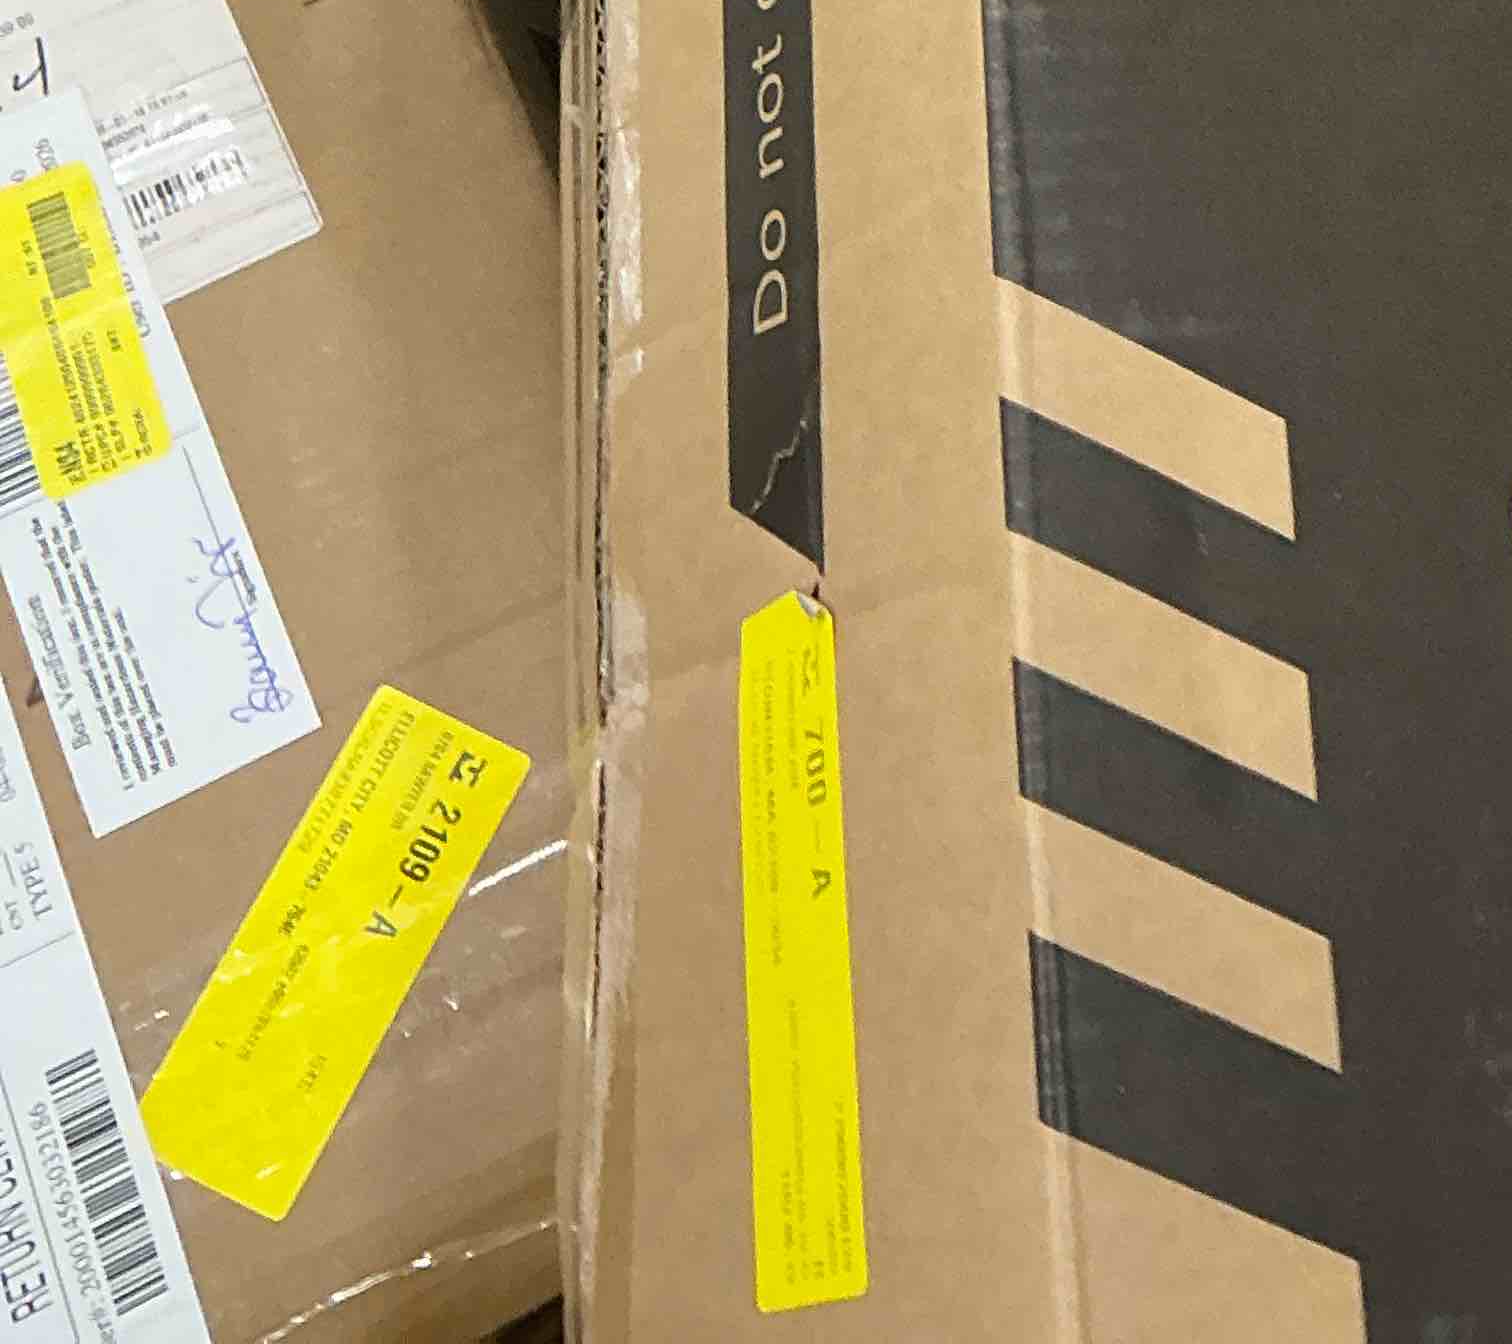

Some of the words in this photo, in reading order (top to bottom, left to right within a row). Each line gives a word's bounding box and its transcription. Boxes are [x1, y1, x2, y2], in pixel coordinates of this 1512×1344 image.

[752, 33, 787, 179] not
[753, 208, 789, 337] Do
[61, 709, 92, 751] Box
[395, 796, 464, 885] 2109
